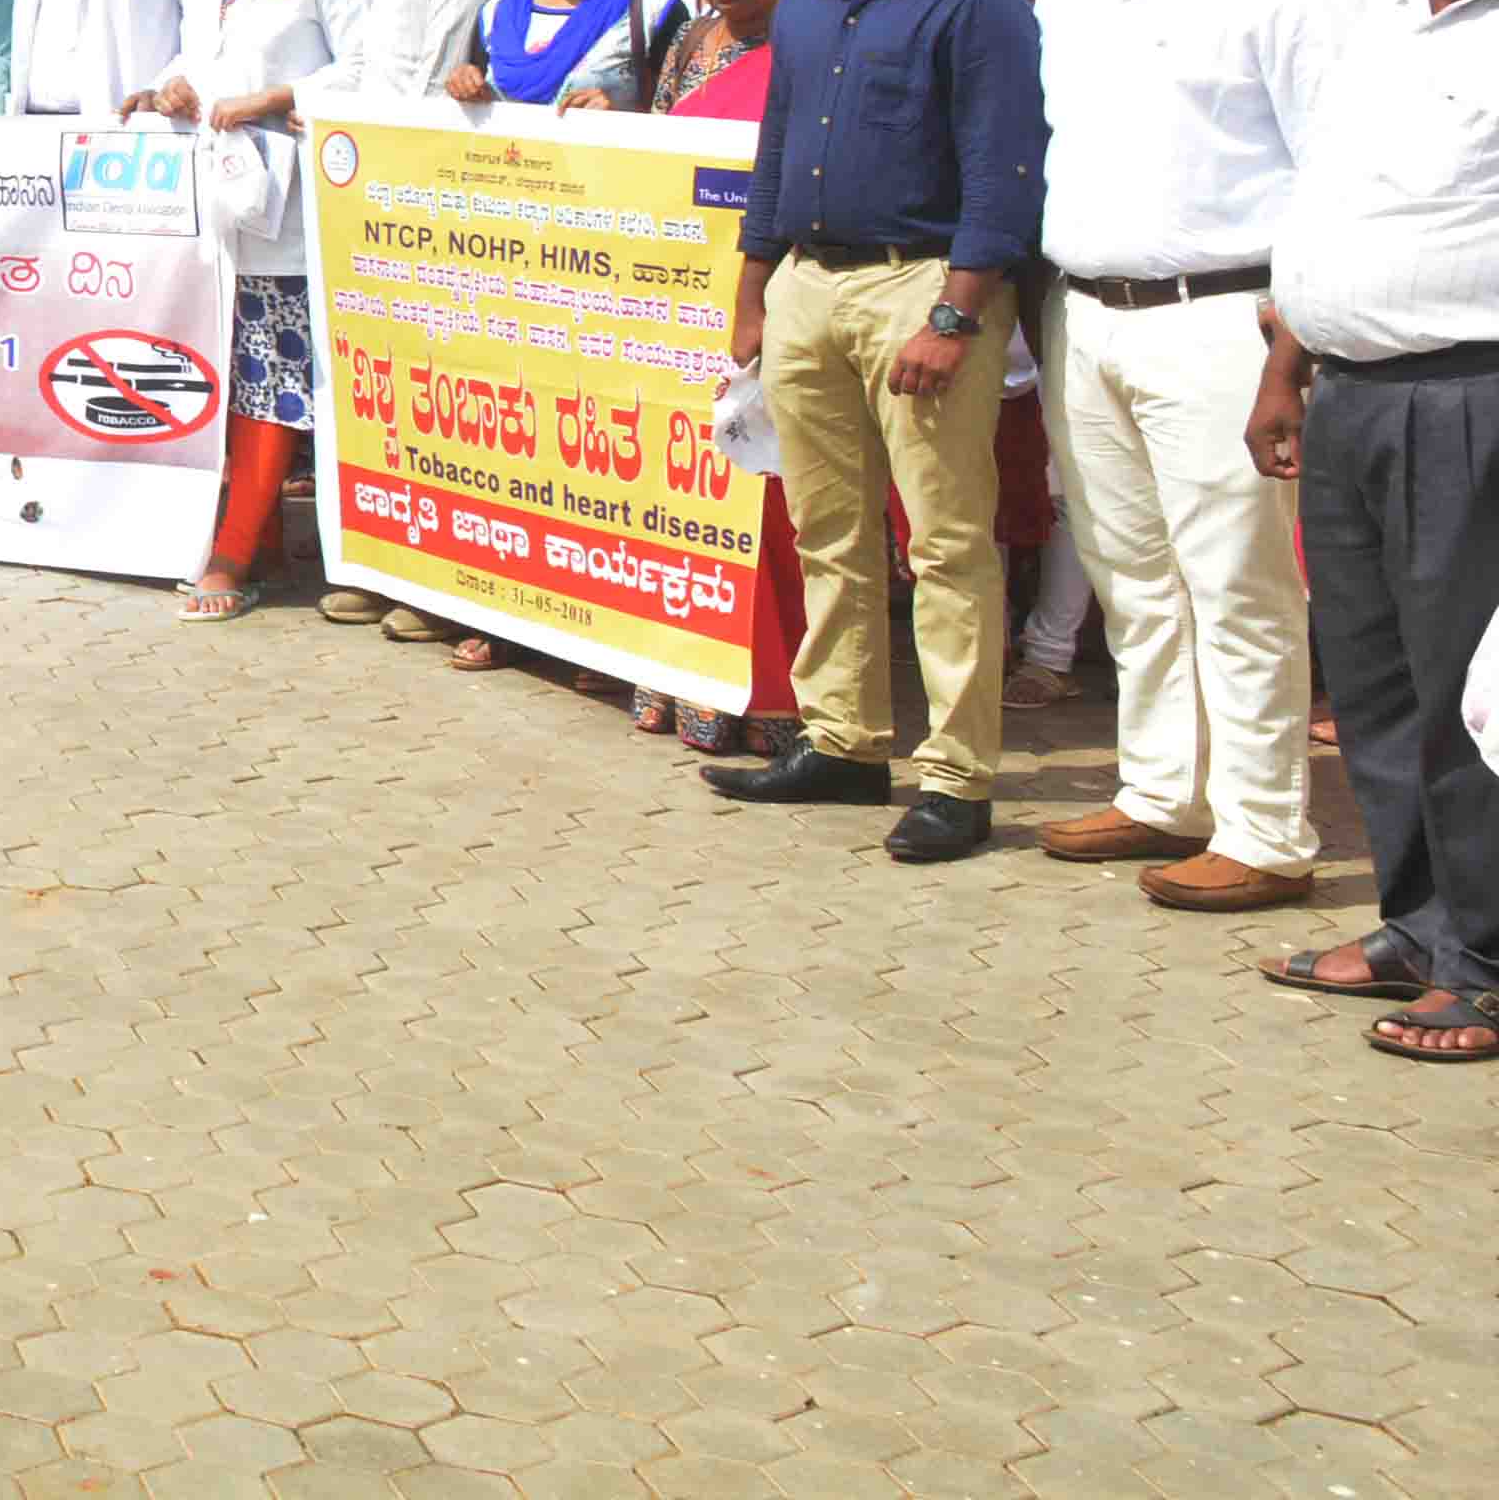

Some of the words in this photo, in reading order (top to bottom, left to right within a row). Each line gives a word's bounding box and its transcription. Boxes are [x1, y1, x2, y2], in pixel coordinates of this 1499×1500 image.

[65, 133, 183, 192] ida
[698, 187, 722, 202] The
[723, 190, 748, 204] Uni
[67, 251, 135, 299] ದಿನ
[363, 219, 438, 254] NTCP,
[447, 230, 531, 269] NOHP,
[539, 244, 621, 284] HIMS,
[632, 261, 713, 292] ಹಾಸನ
[409, 350, 538, 460] ತಂಬಾಕು
[555, 372, 644, 483] ರಹಿತ
[406, 444, 501, 494] Tobacco
[509, 478, 554, 508] and
[562, 483, 632, 528] heart
[643, 505, 754, 555] disease
[510, 587, 594, 628] 31-05-2018
[544, 531, 736, 618] ಕಾರ್ಯಕ್ರಮ
